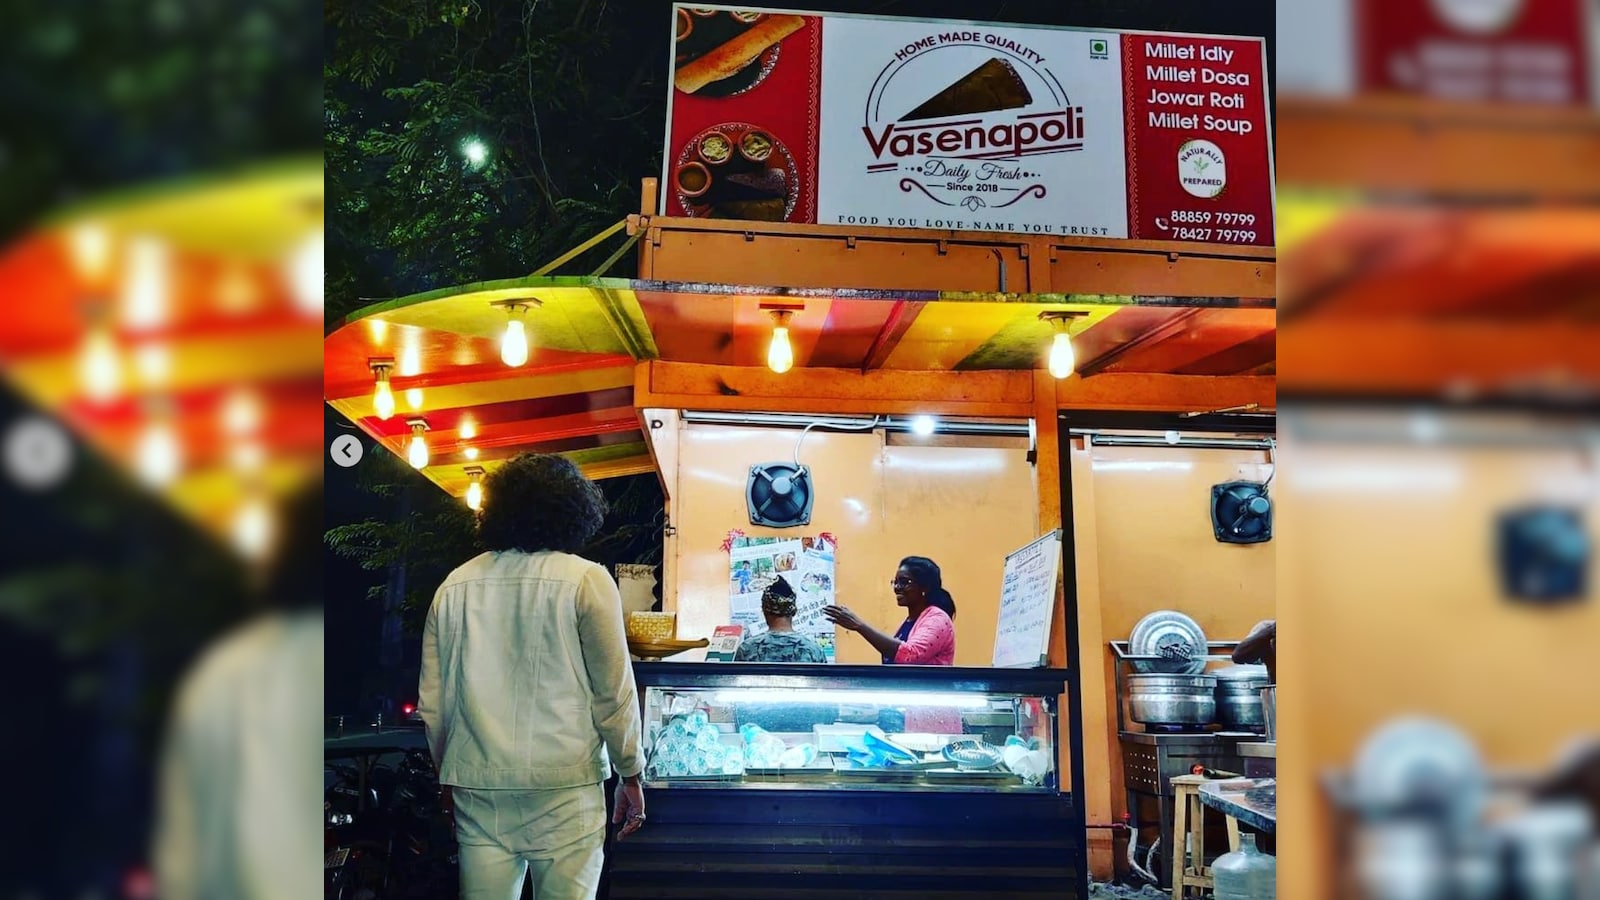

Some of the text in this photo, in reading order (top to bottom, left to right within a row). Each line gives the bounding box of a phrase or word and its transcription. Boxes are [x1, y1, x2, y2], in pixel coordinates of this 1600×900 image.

[895, 32, 1045, 65] HOME MADE QUALITY
[1145, 42, 1234, 65] Millet Idly
[1146, 65, 1250, 86] Millet Dosa
[1147, 88, 1245, 109] Jowar Roti
[862, 106, 1084, 160] Vasenapoli
[1149, 112, 1253, 135] Millet Soup
[1181, 147, 1223, 164] NATURALLY
[923, 159, 1022, 183] Daily Fresh
[1183, 177, 1222, 186] PREPARED
[946, 182, 998, 192] Since 2018
[838, 215, 879, 225] FOOD
[887, 217, 917, 227] YOU
[1023, 223, 1052, 233] YOU
[1060, 225, 1108, 235] TRUST
[1171, 210, 1255, 226] 88859 79799
[1172, 227, 1257, 242] 78427 79799
